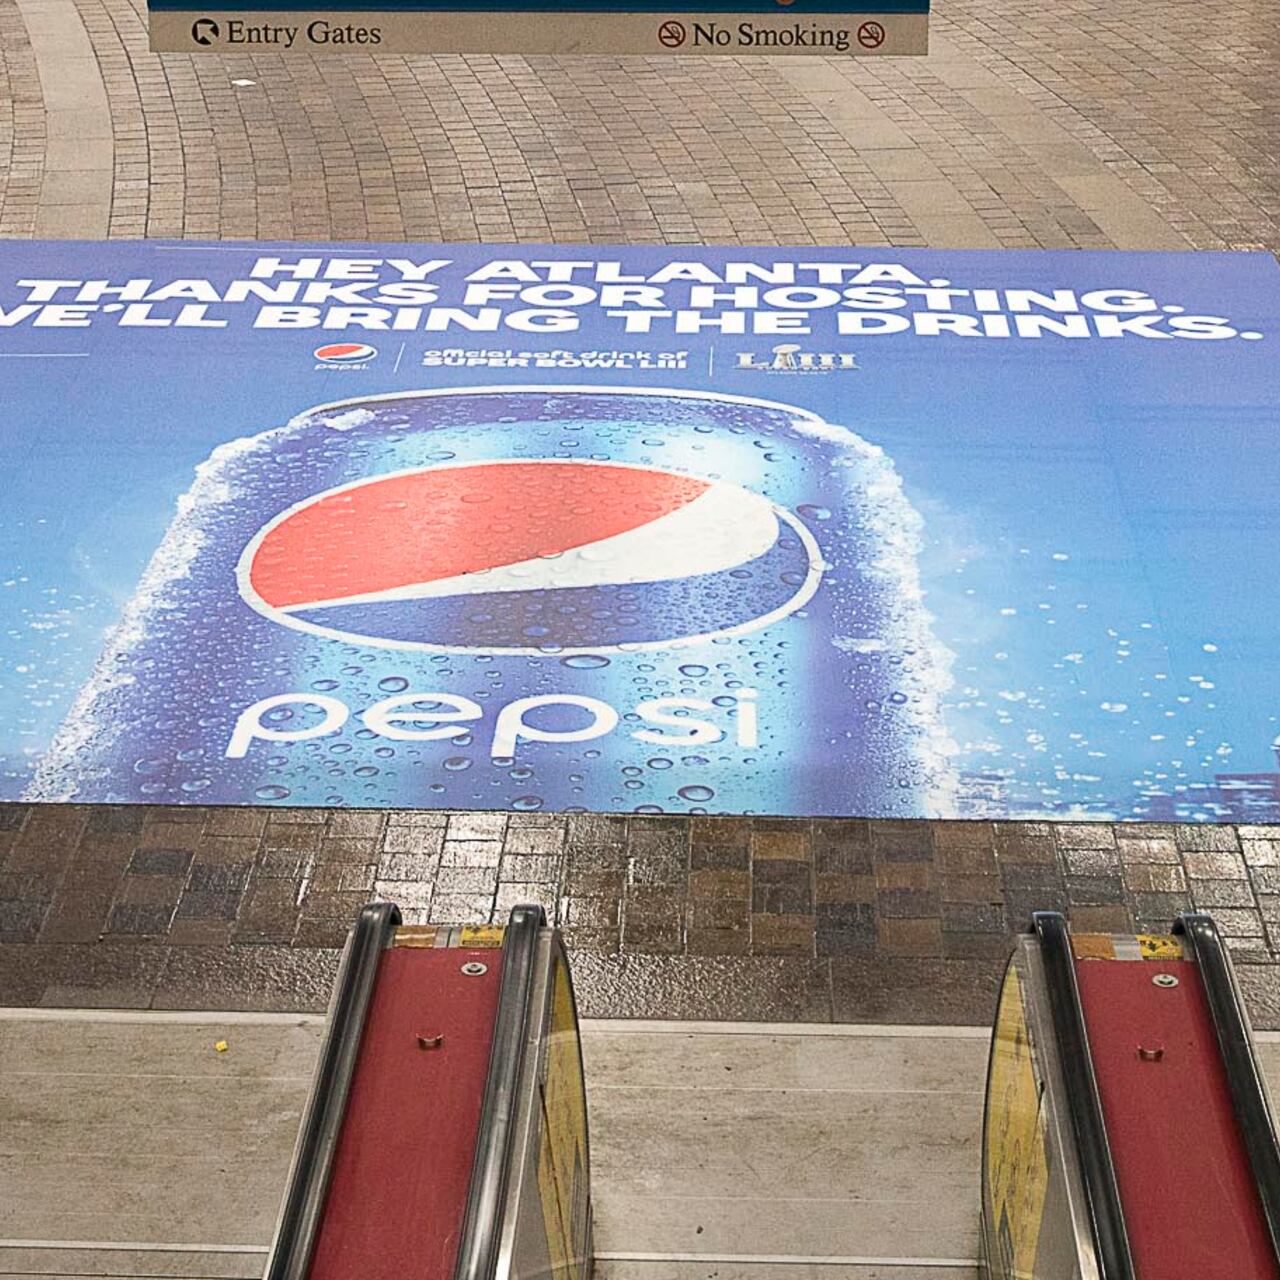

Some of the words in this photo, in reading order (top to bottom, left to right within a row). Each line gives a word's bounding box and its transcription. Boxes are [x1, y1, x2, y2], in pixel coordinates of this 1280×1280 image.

[226, 20, 299, 48] Entry
[308, 20, 381, 45] Gates
[692, 22, 730, 46] No
[738, 21, 850, 50] Smoking
[249, 257, 458, 282] HEY
[463, 259, 951, 288] ATLANTA.
[17, 279, 438, 305] THANKS
[462, 281, 669, 308] FOR
[689, 285, 1185, 314] HOSTING.
[252, 305, 581, 333] BRING
[606, 310, 830, 336] THE
[837, 311, 1265, 340] DRINKS.
[421, 357, 529, 367] SUPER
[534, 357, 634, 368] BOWL
[638, 359, 688, 369] LIII
[423, 348, 512, 359] official
[518, 349, 574, 359] soft
[579, 349, 652, 359] drink
[657, 350, 690, 360] of
[225, 688, 759, 759] pepsi
